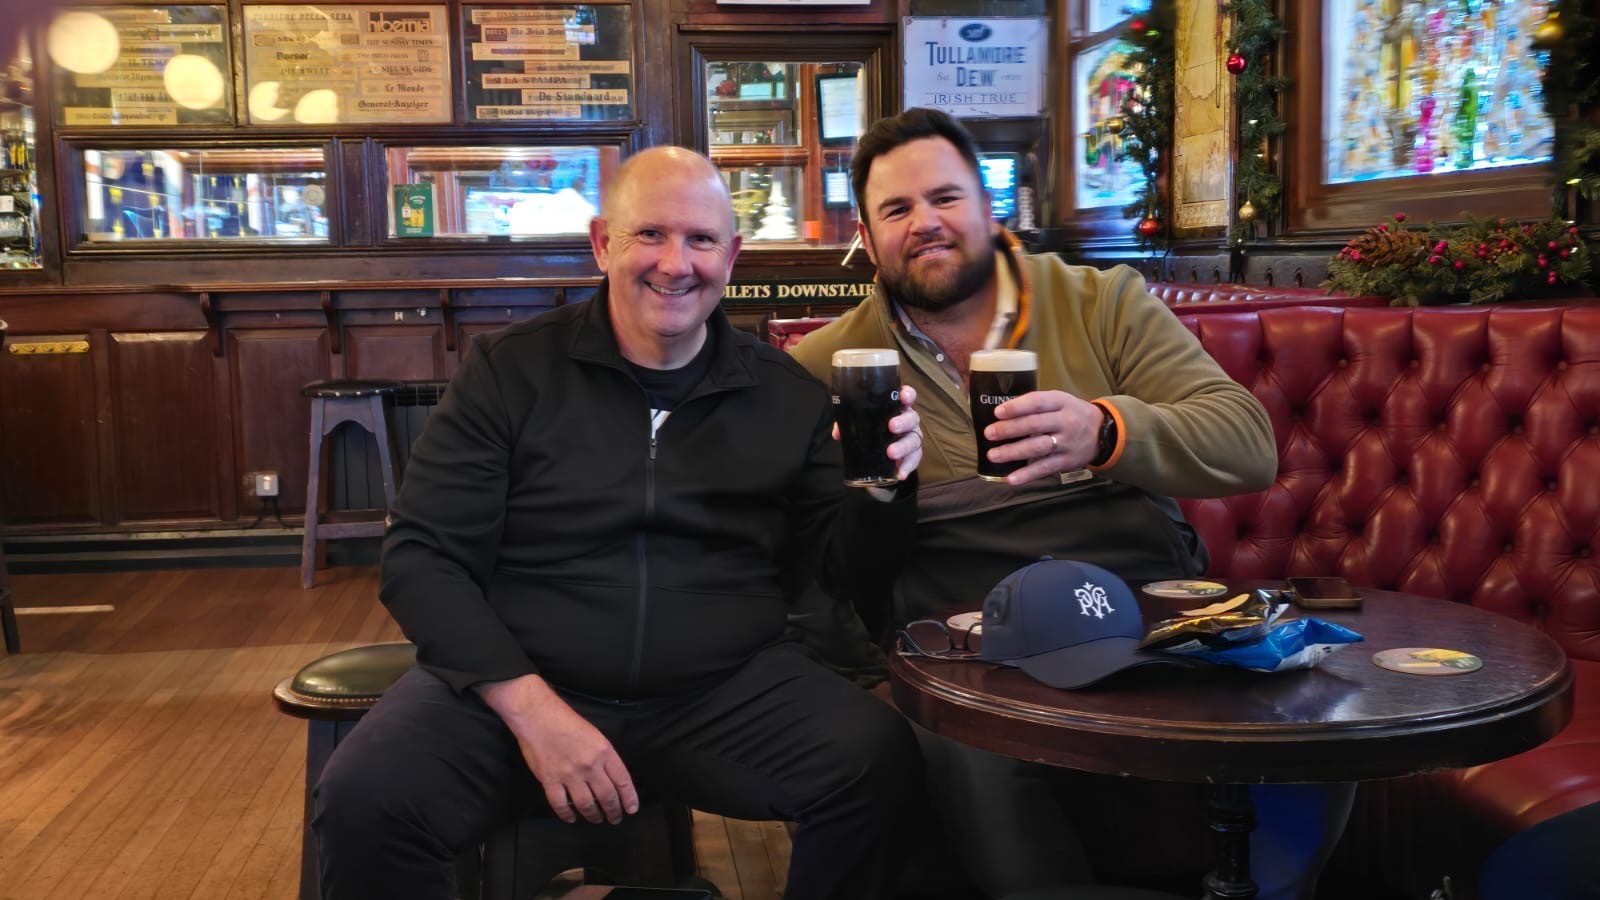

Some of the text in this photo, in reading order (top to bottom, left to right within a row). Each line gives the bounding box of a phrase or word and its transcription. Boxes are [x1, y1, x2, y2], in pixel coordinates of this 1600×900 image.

[367, 12, 430, 33] hibernia
[925, 41, 1027, 66] TULLAMORE
[397, 83, 425, 93] Monde
[934, 93, 1017, 104] IRISH TRUE
[725, 283, 875, 298] ILETS DOWNSTAIR
